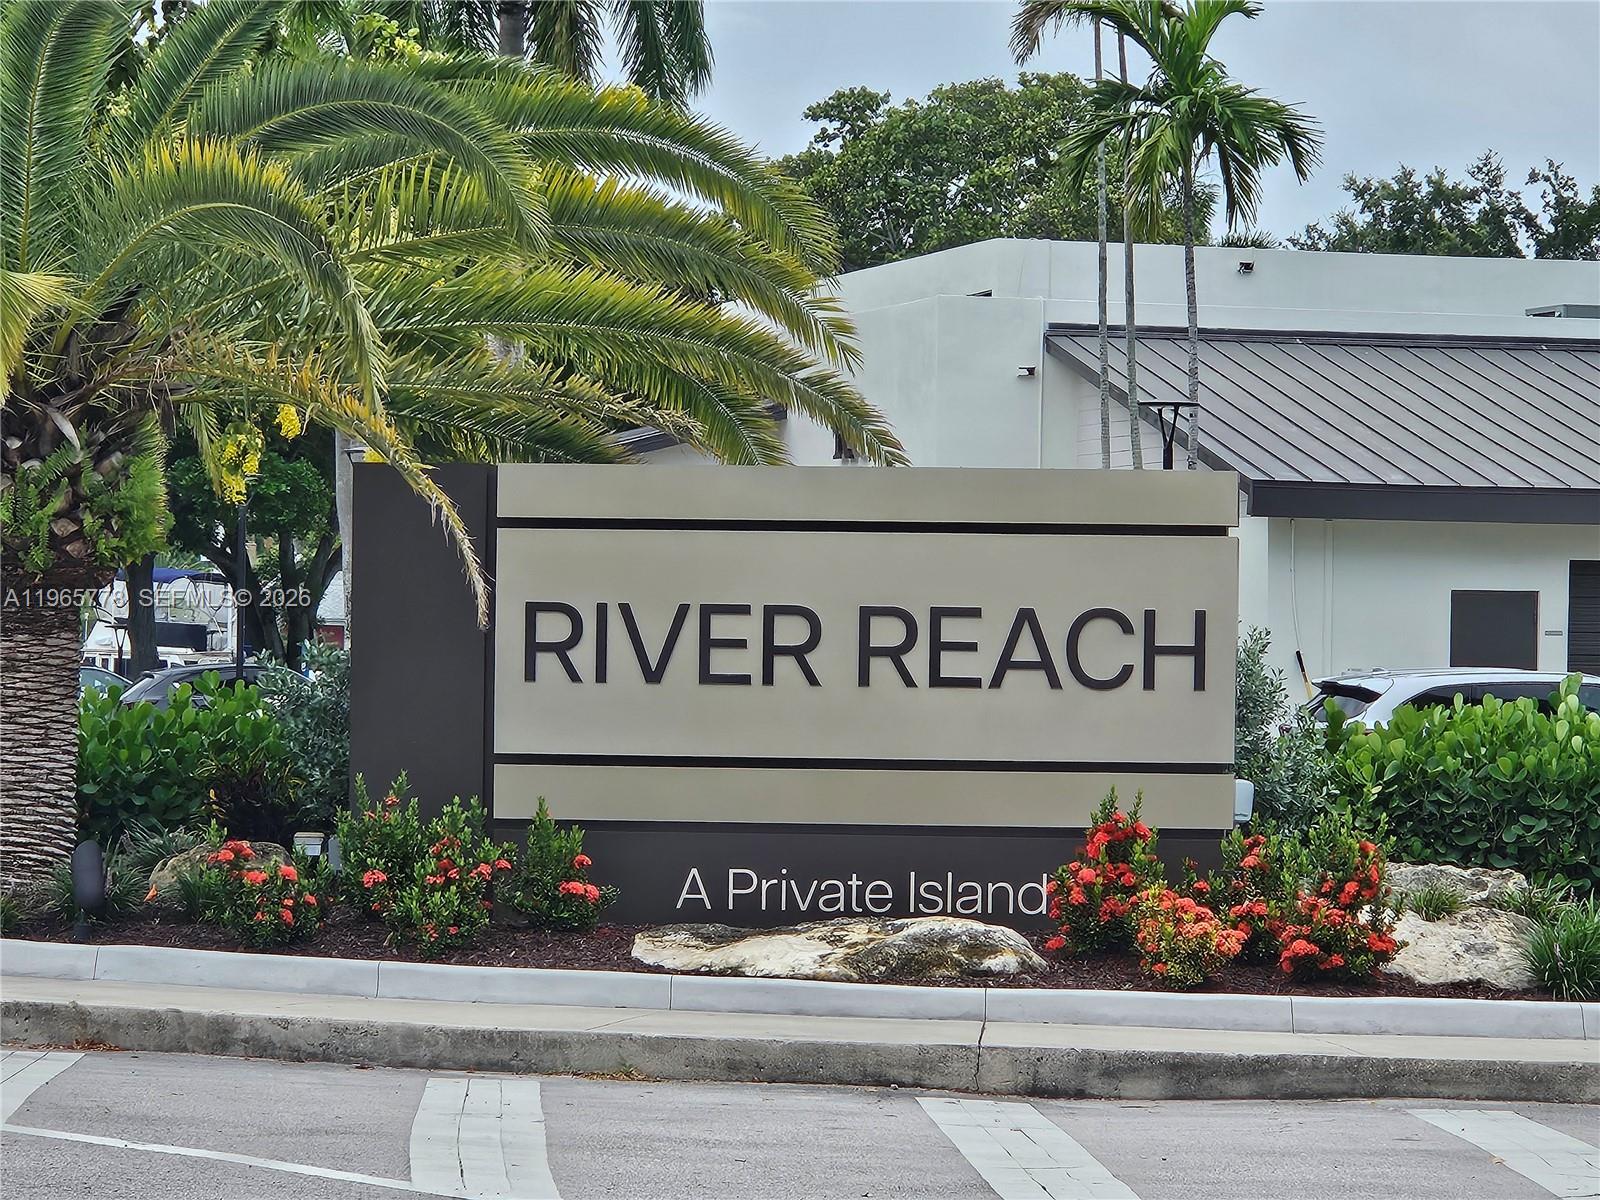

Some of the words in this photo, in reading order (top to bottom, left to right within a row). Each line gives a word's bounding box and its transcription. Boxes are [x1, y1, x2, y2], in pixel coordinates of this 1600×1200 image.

[524, 601, 823, 688] RIVER
[857, 605, 1207, 692] REACH
[675, 867, 712, 910] A
[728, 868, 893, 913] Private
[909, 871, 1047, 915] Island
